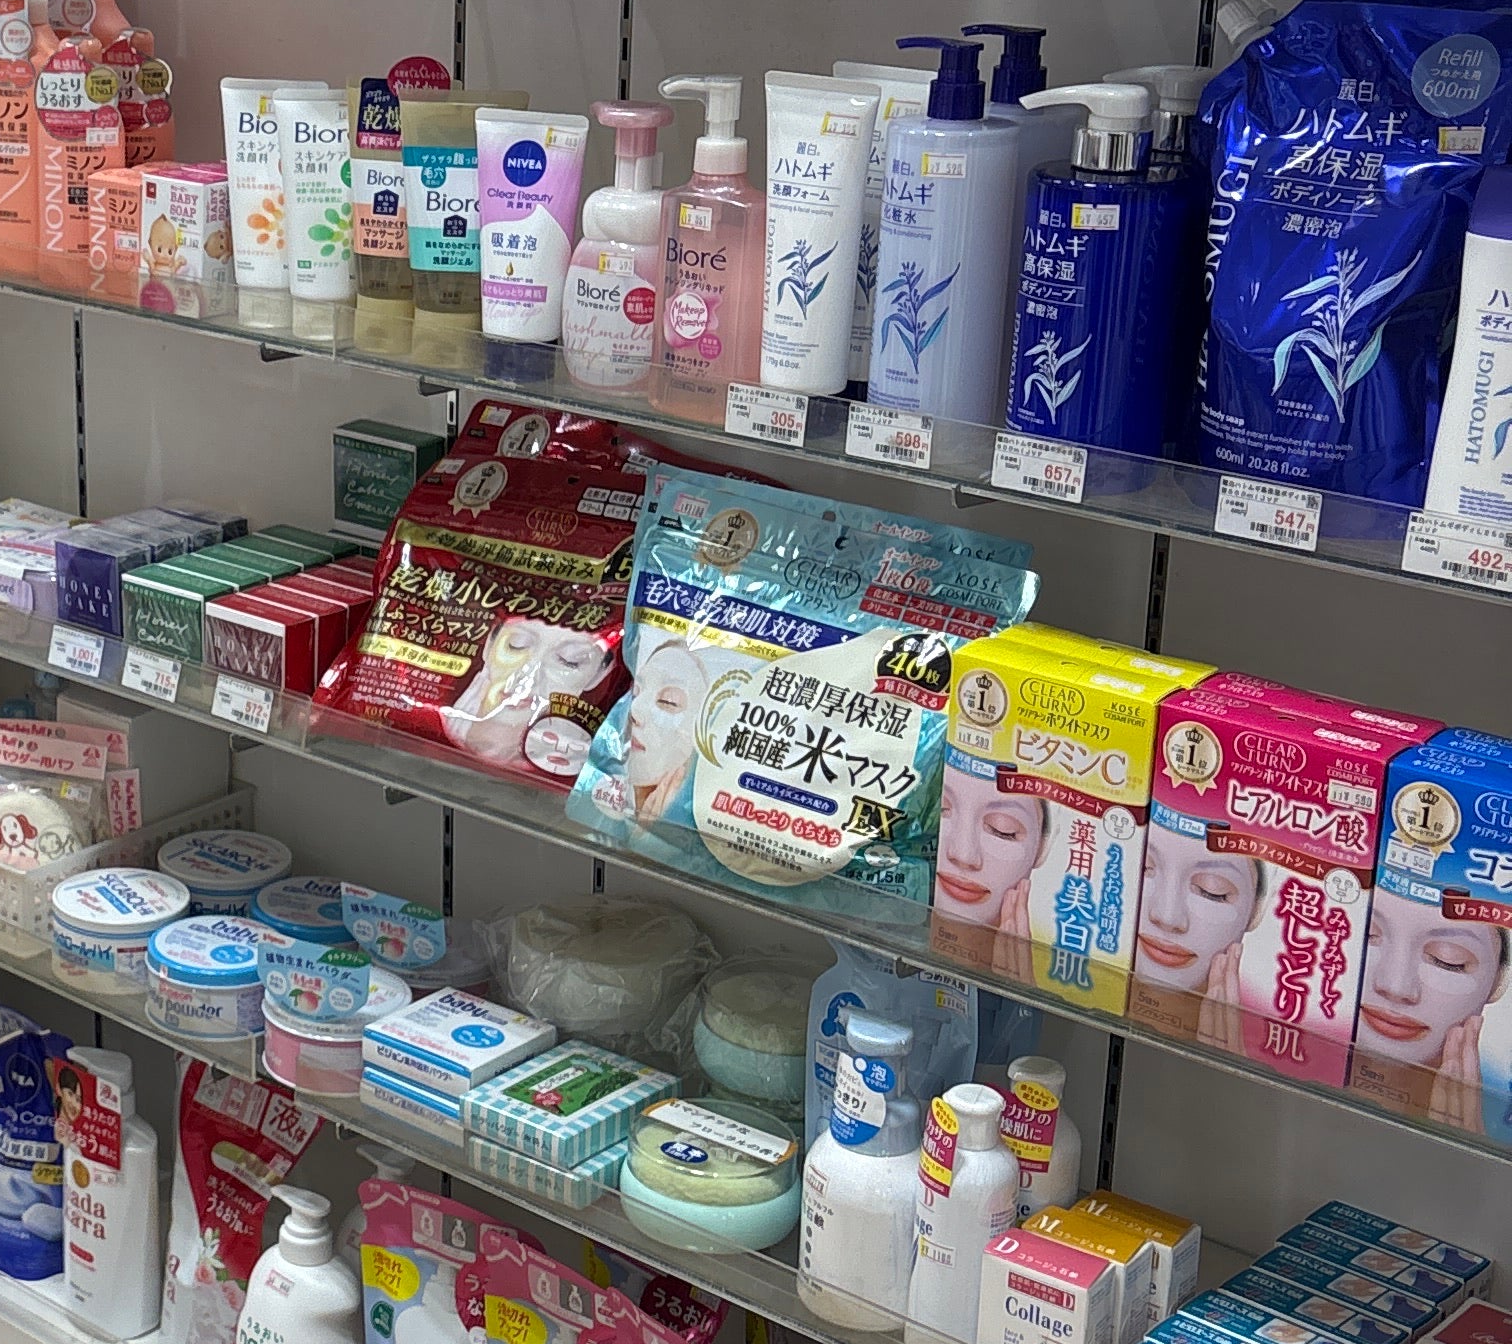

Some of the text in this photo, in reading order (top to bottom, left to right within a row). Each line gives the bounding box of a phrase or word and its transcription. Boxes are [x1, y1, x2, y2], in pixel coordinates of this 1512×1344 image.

[1437, 48, 1484, 68] Refill
[506, 157, 545, 171] NIVEA
[774, 157, 835, 182] ハトムギ
[666, 236, 728, 271] Bioré
[1022, 232, 1089, 258] ハトムギ
[577, 277, 621, 301] Bioré
[1012, 729, 1128, 787] ビタミンC
[1227, 791, 1367, 853] ヒアルロン酸
[1004, 1294, 1074, 1338] Collage
